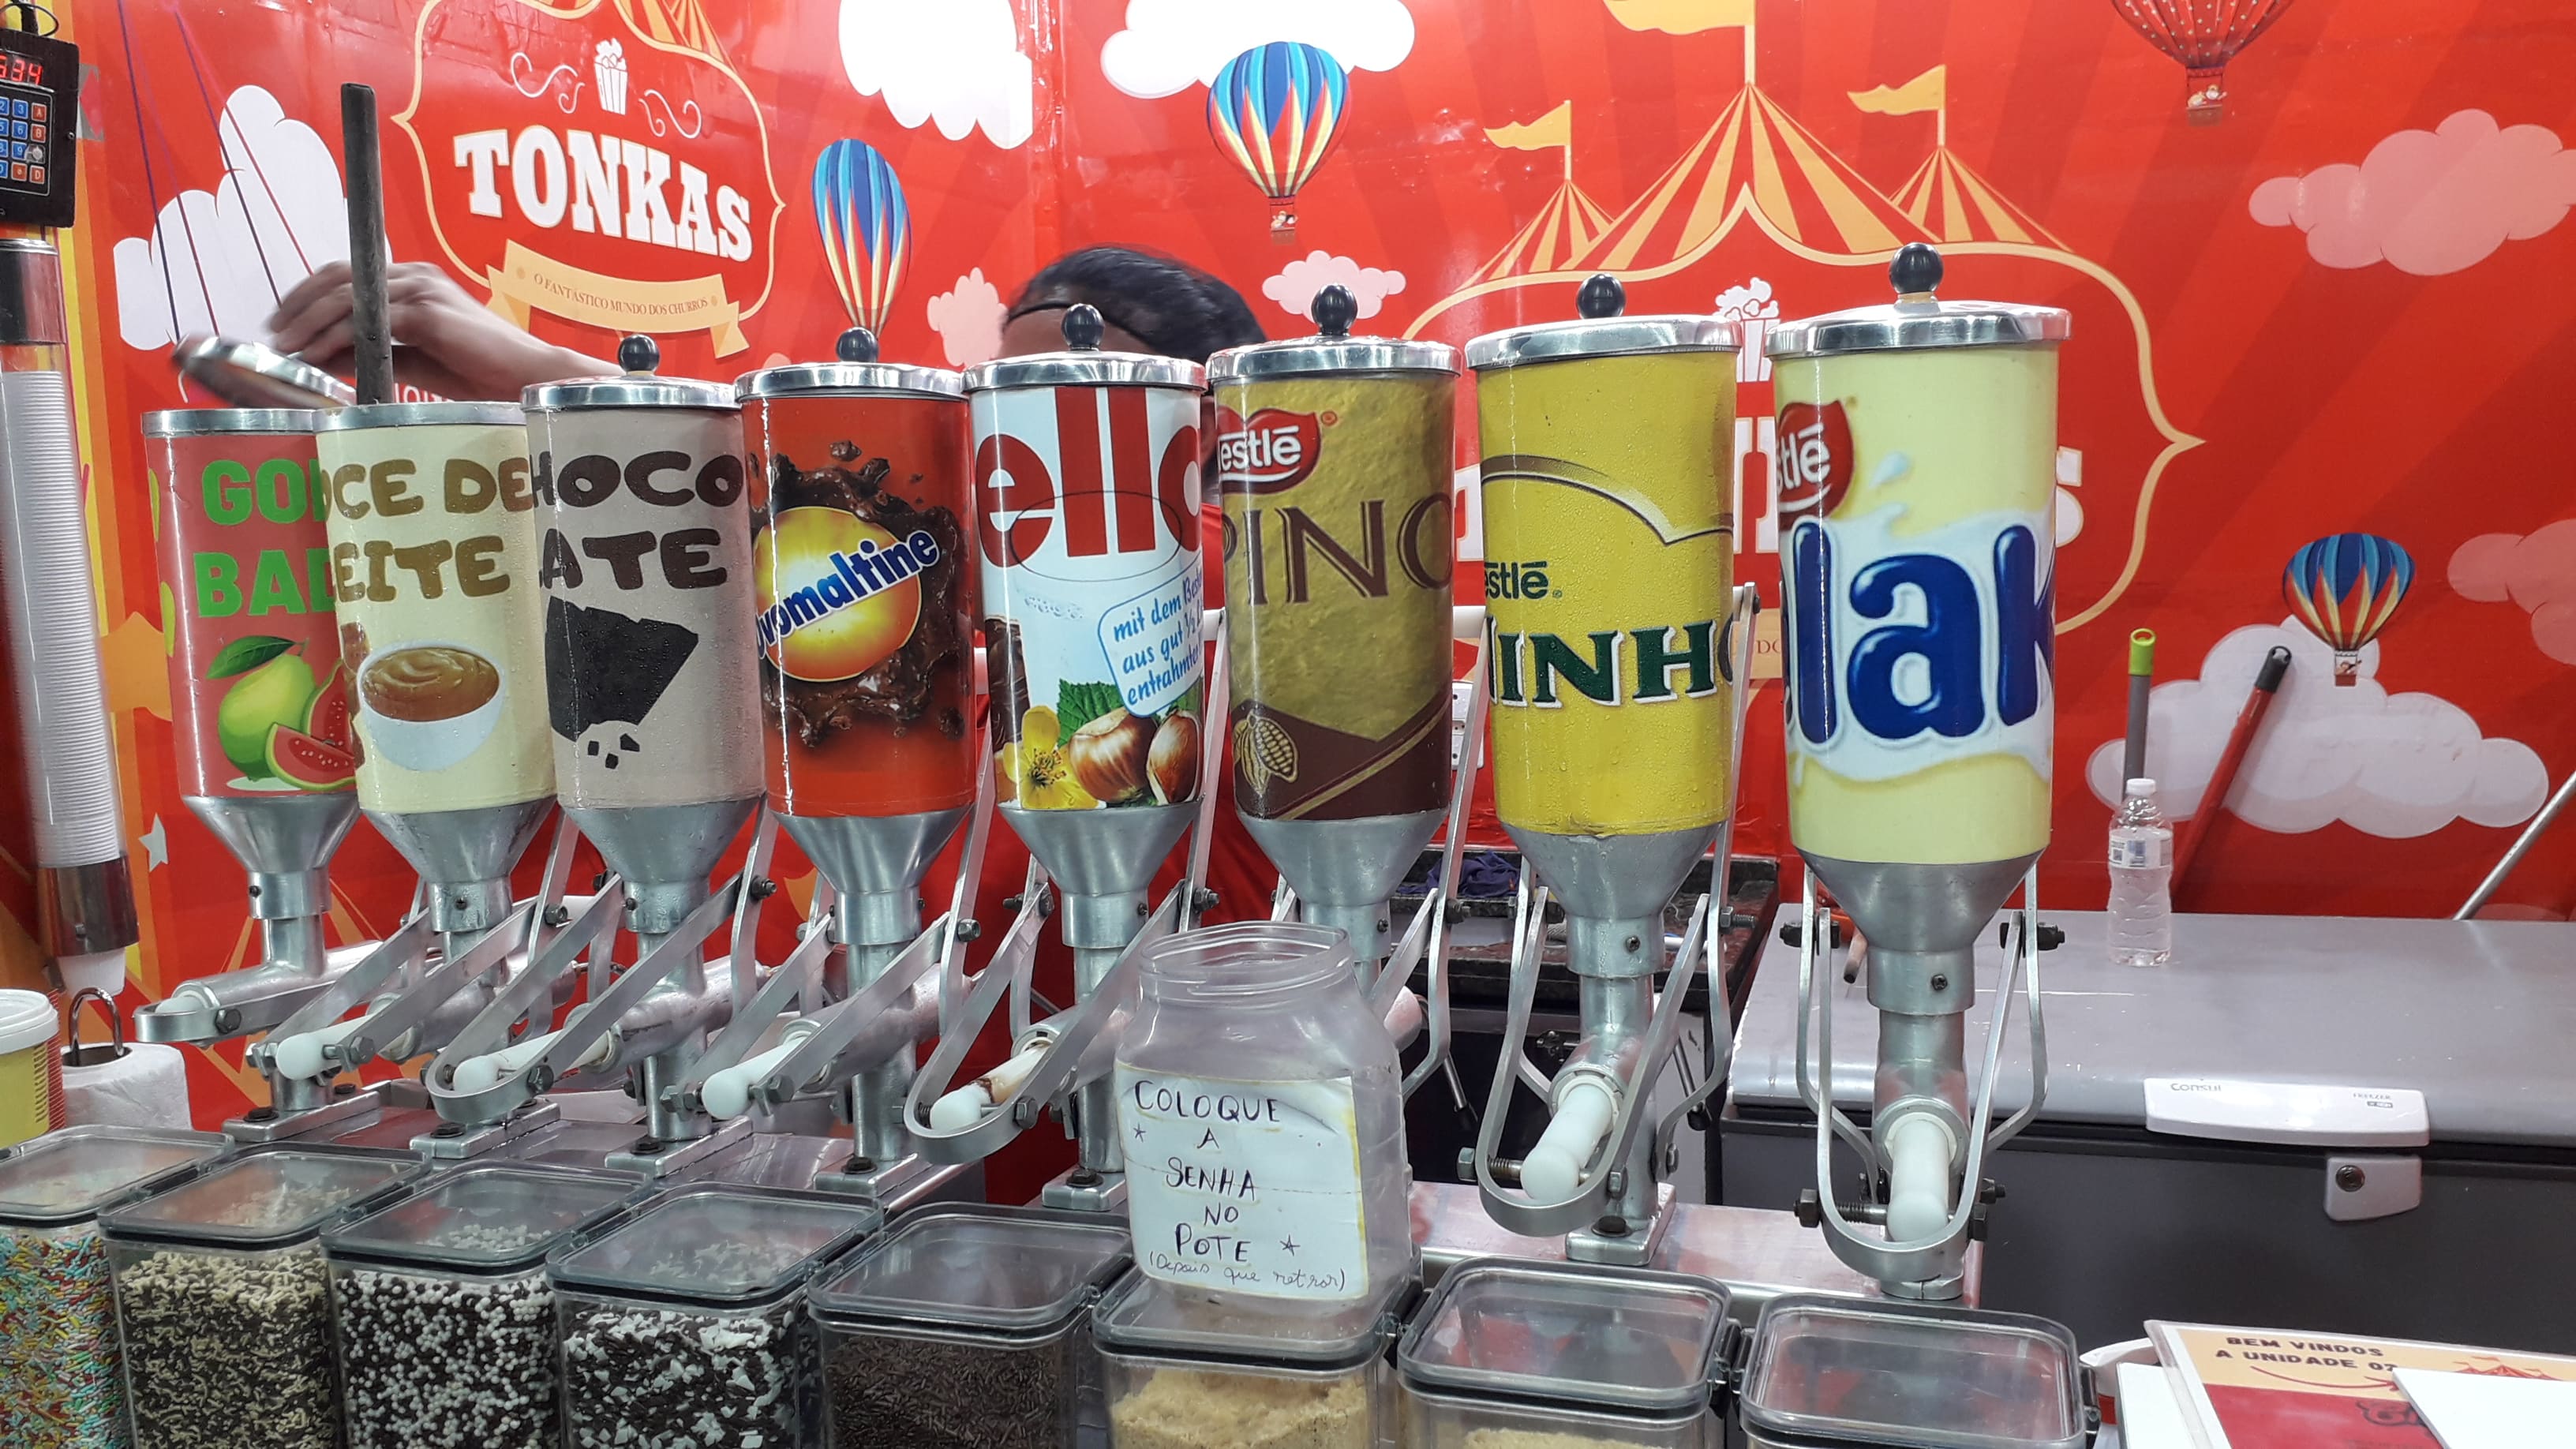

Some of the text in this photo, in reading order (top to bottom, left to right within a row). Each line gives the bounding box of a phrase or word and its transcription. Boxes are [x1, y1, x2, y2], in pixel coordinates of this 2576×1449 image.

[453, 125, 753, 262] TONKAS
[534, 273, 544, 285] O
[610, 299, 647, 315] MUNDO
[649, 303, 668, 315] DOS
[668, 298, 708, 314] CHURROS
[444, 457, 534, 514] DE
[334, 535, 511, 602] EITE
[539, 528, 728, 590] ATE
[1114, 606, 1145, 642] mit
[1151, 597, 1182, 626] dem
[1780, 522, 2054, 743] lak
[1123, 646, 1155, 674] aus
[1160, 620, 1184, 661] gut
[1487, 613, 1733, 708] INH
[1134, 1080, 1281, 1123] COLOQUE
[1196, 1127, 1220, 1149] A
[1166, 1156, 1255, 1201] SENHA
[1204, 1202, 1239, 1226] NO
[1174, 1222, 1252, 1262] POTE
[1223, 1267, 1261, 1286] que
[2215, 1350, 2233, 1359] A
[2242, 1351, 2358, 1368] UNIDADE
[2226, 1336, 2384, 1357] BEM VINDOS
